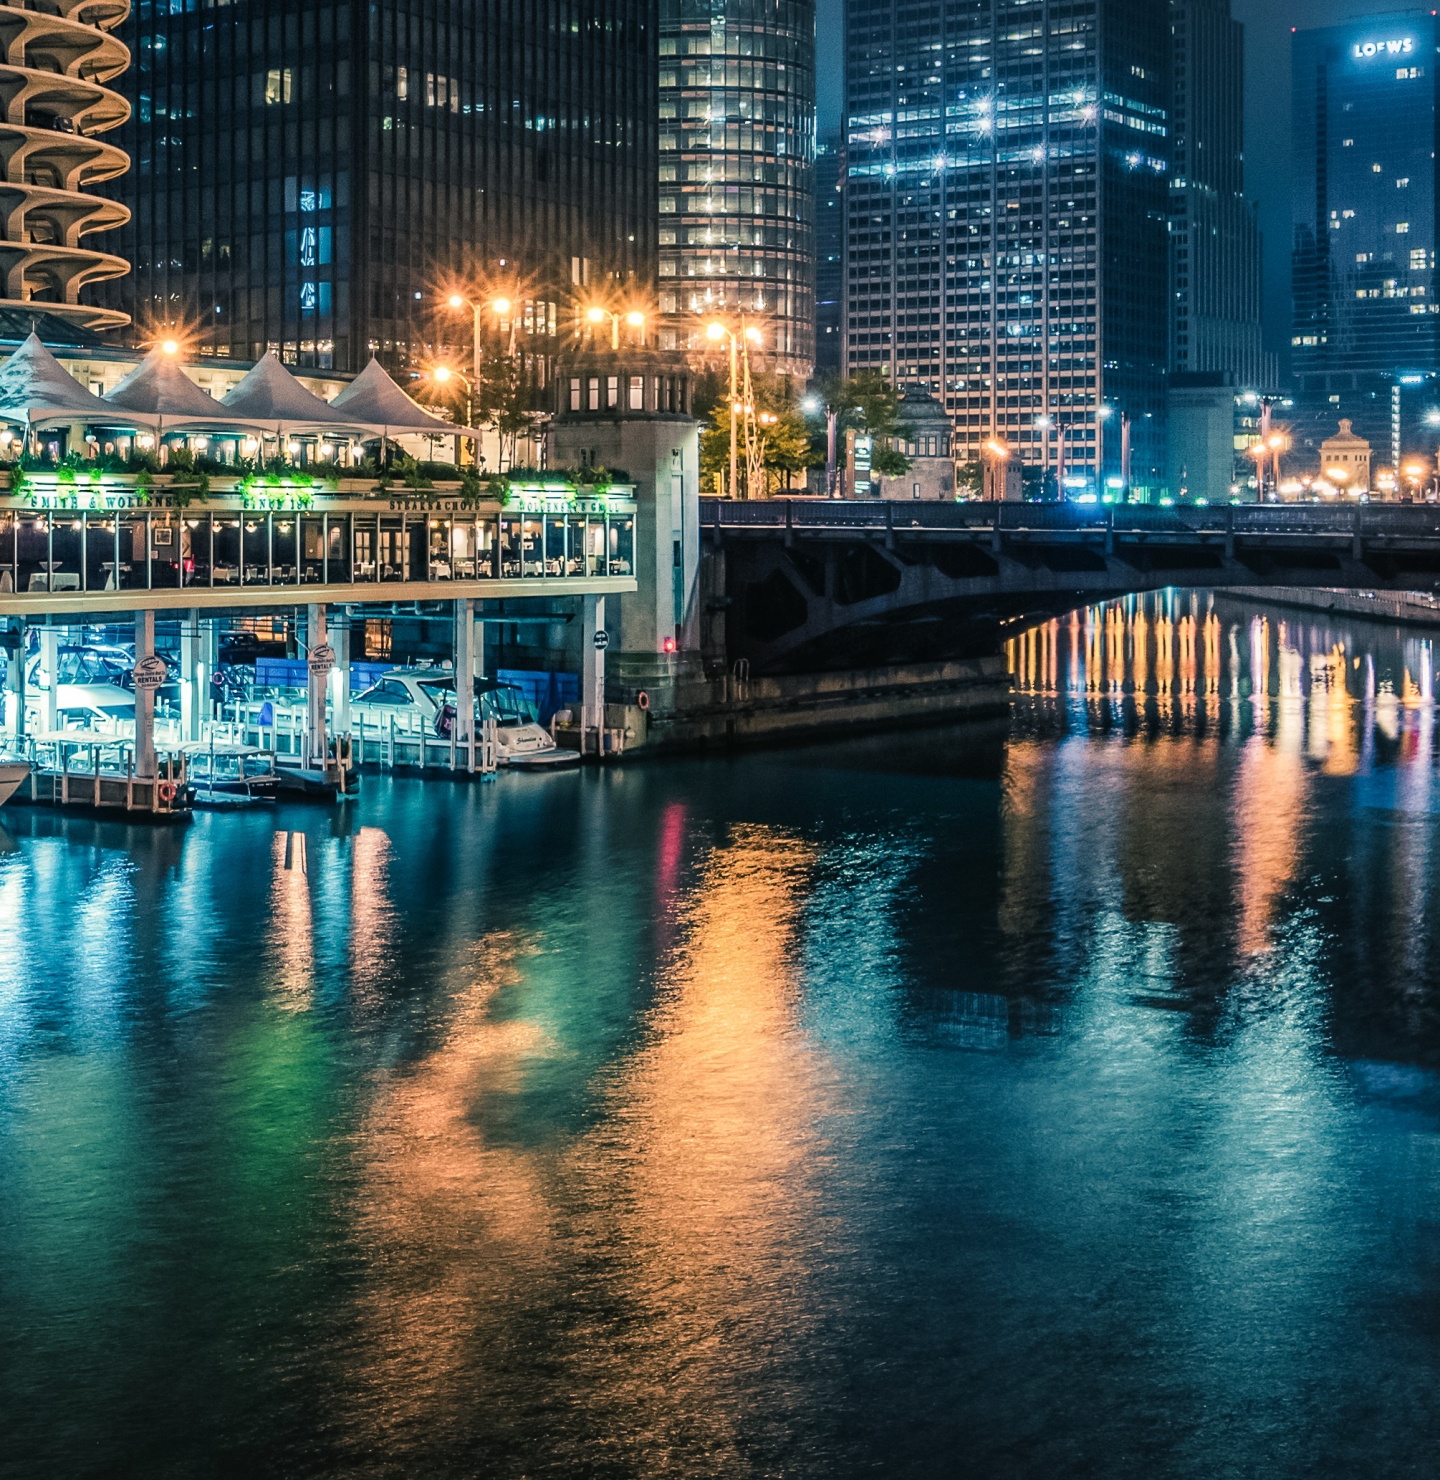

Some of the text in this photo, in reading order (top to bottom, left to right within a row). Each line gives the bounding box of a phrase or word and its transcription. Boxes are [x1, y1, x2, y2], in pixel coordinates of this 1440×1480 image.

[31, 495, 189, 509] SMITH & WOLLENS
[591, 502, 619, 513] GRLL
[137, 676, 163, 684] RENTALS
